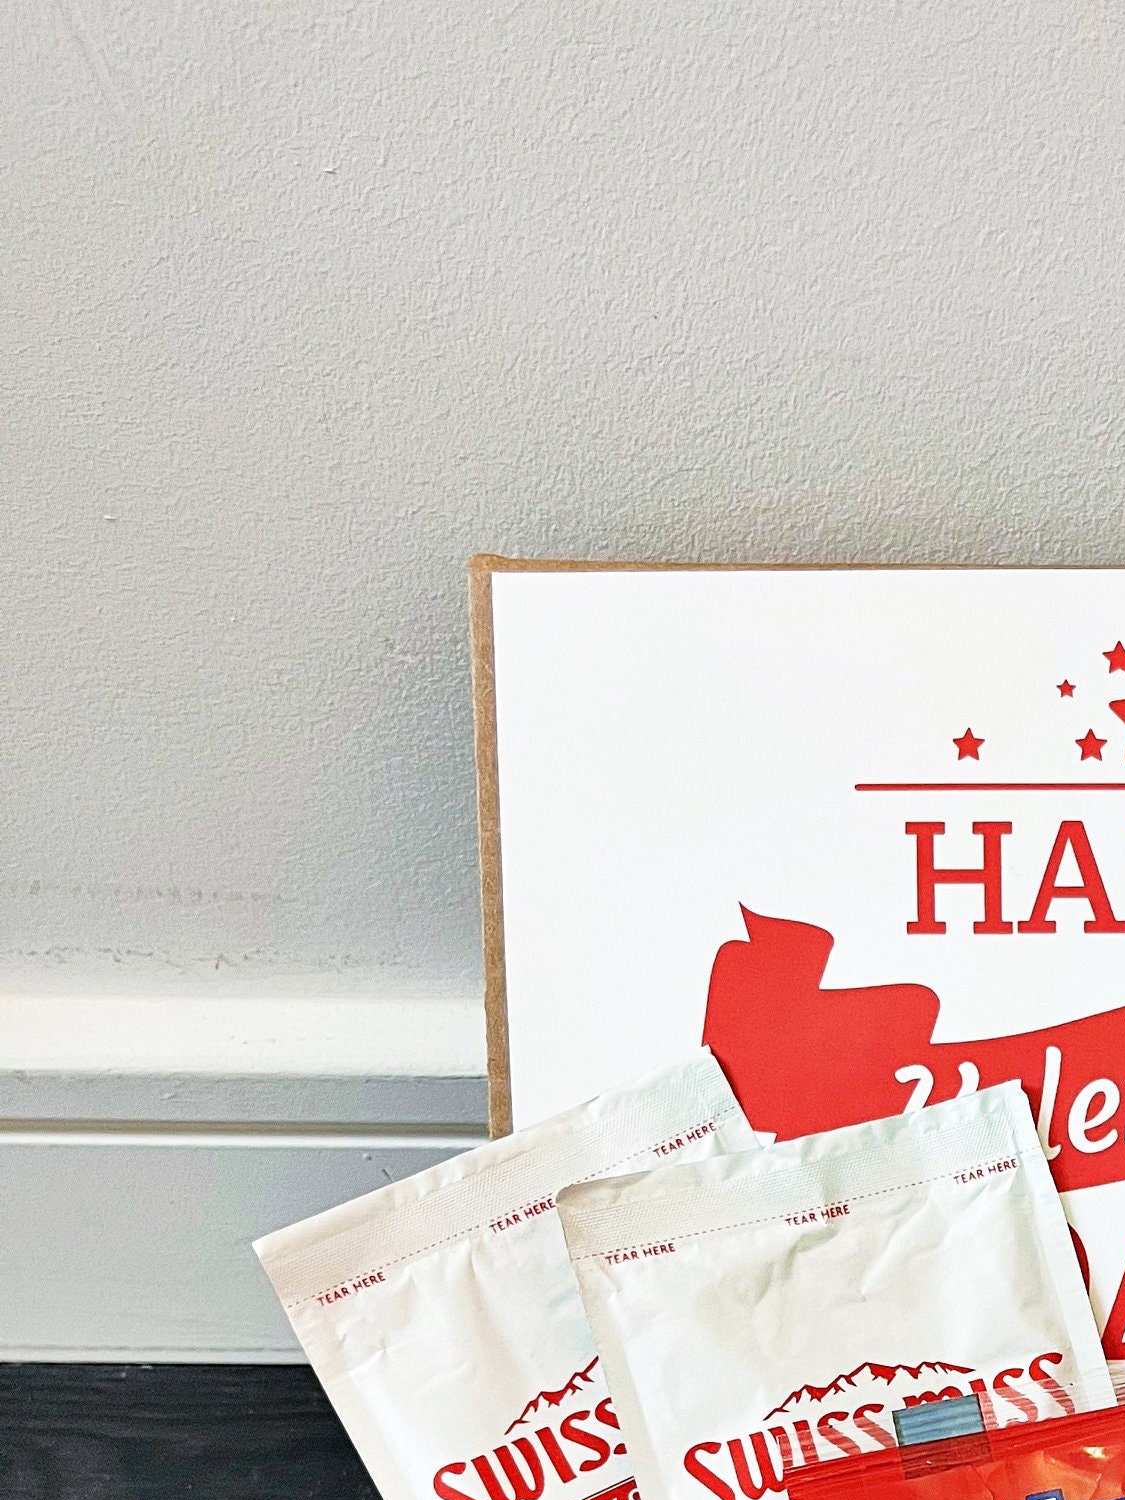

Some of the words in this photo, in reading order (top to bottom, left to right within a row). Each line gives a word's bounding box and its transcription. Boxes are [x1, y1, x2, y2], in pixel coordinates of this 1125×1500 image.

[653, 1137, 685, 1159] TEAR
[686, 1121, 718, 1146] HERE
[953, 1168, 985, 1186] TEAR
[988, 1157, 1019, 1177] HERE
[489, 1213, 523, 1235] TEAR
[523, 1198, 556, 1221] HERE
[785, 1211, 818, 1227] TEAR
[820, 1204, 851, 1221] HERE
[606, 1249, 640, 1266] TEAR
[643, 1242, 677, 1259] HERE
[317, 1285, 351, 1308] TEAR
[352, 1271, 386, 1296] HERE
[902, 1352, 1076, 1430] ISS
